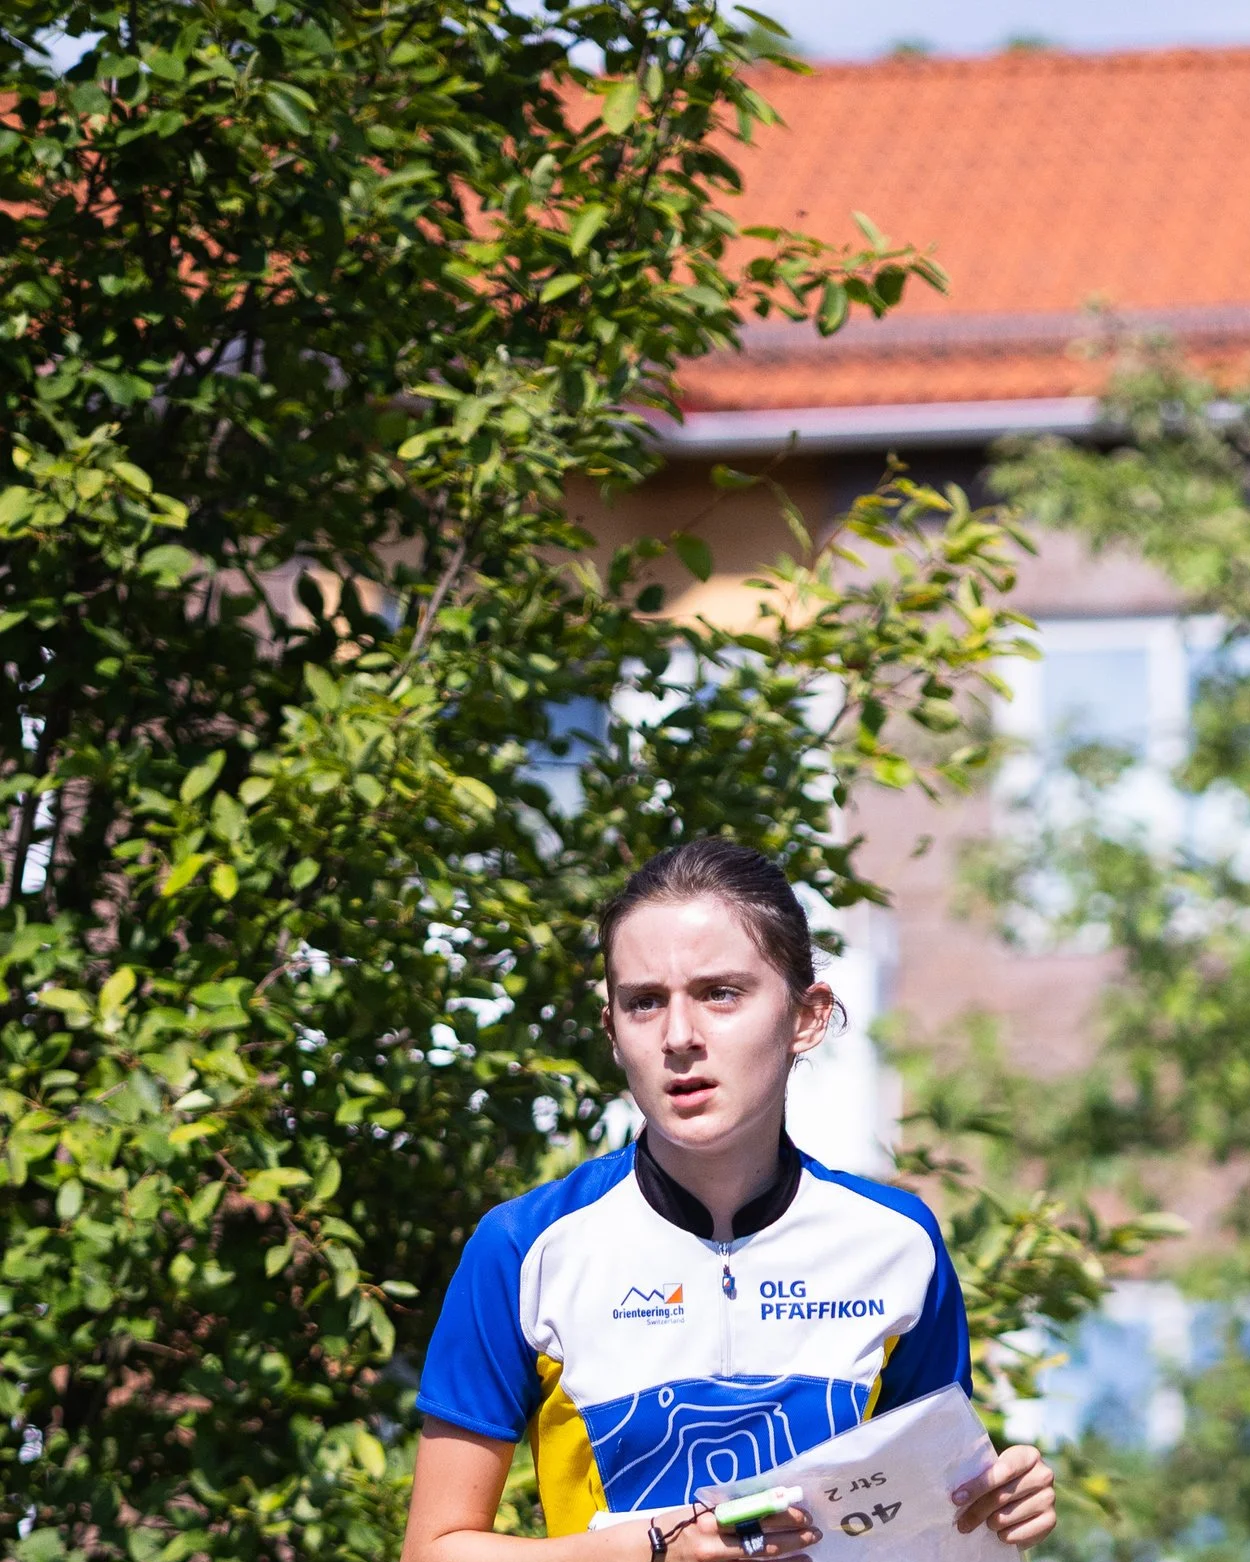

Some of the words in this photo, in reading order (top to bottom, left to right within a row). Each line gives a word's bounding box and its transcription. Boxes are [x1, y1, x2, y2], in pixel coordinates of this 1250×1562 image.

[759, 1280, 806, 1299] OLG
[612, 1305, 685, 1320] Orienteering.ch
[761, 1299, 885, 1320] PFÄFFIKON
[850, 1472, 887, 1492] Str
[823, 1487, 843, 1502] 2
[840, 1501, 902, 1537] 40
